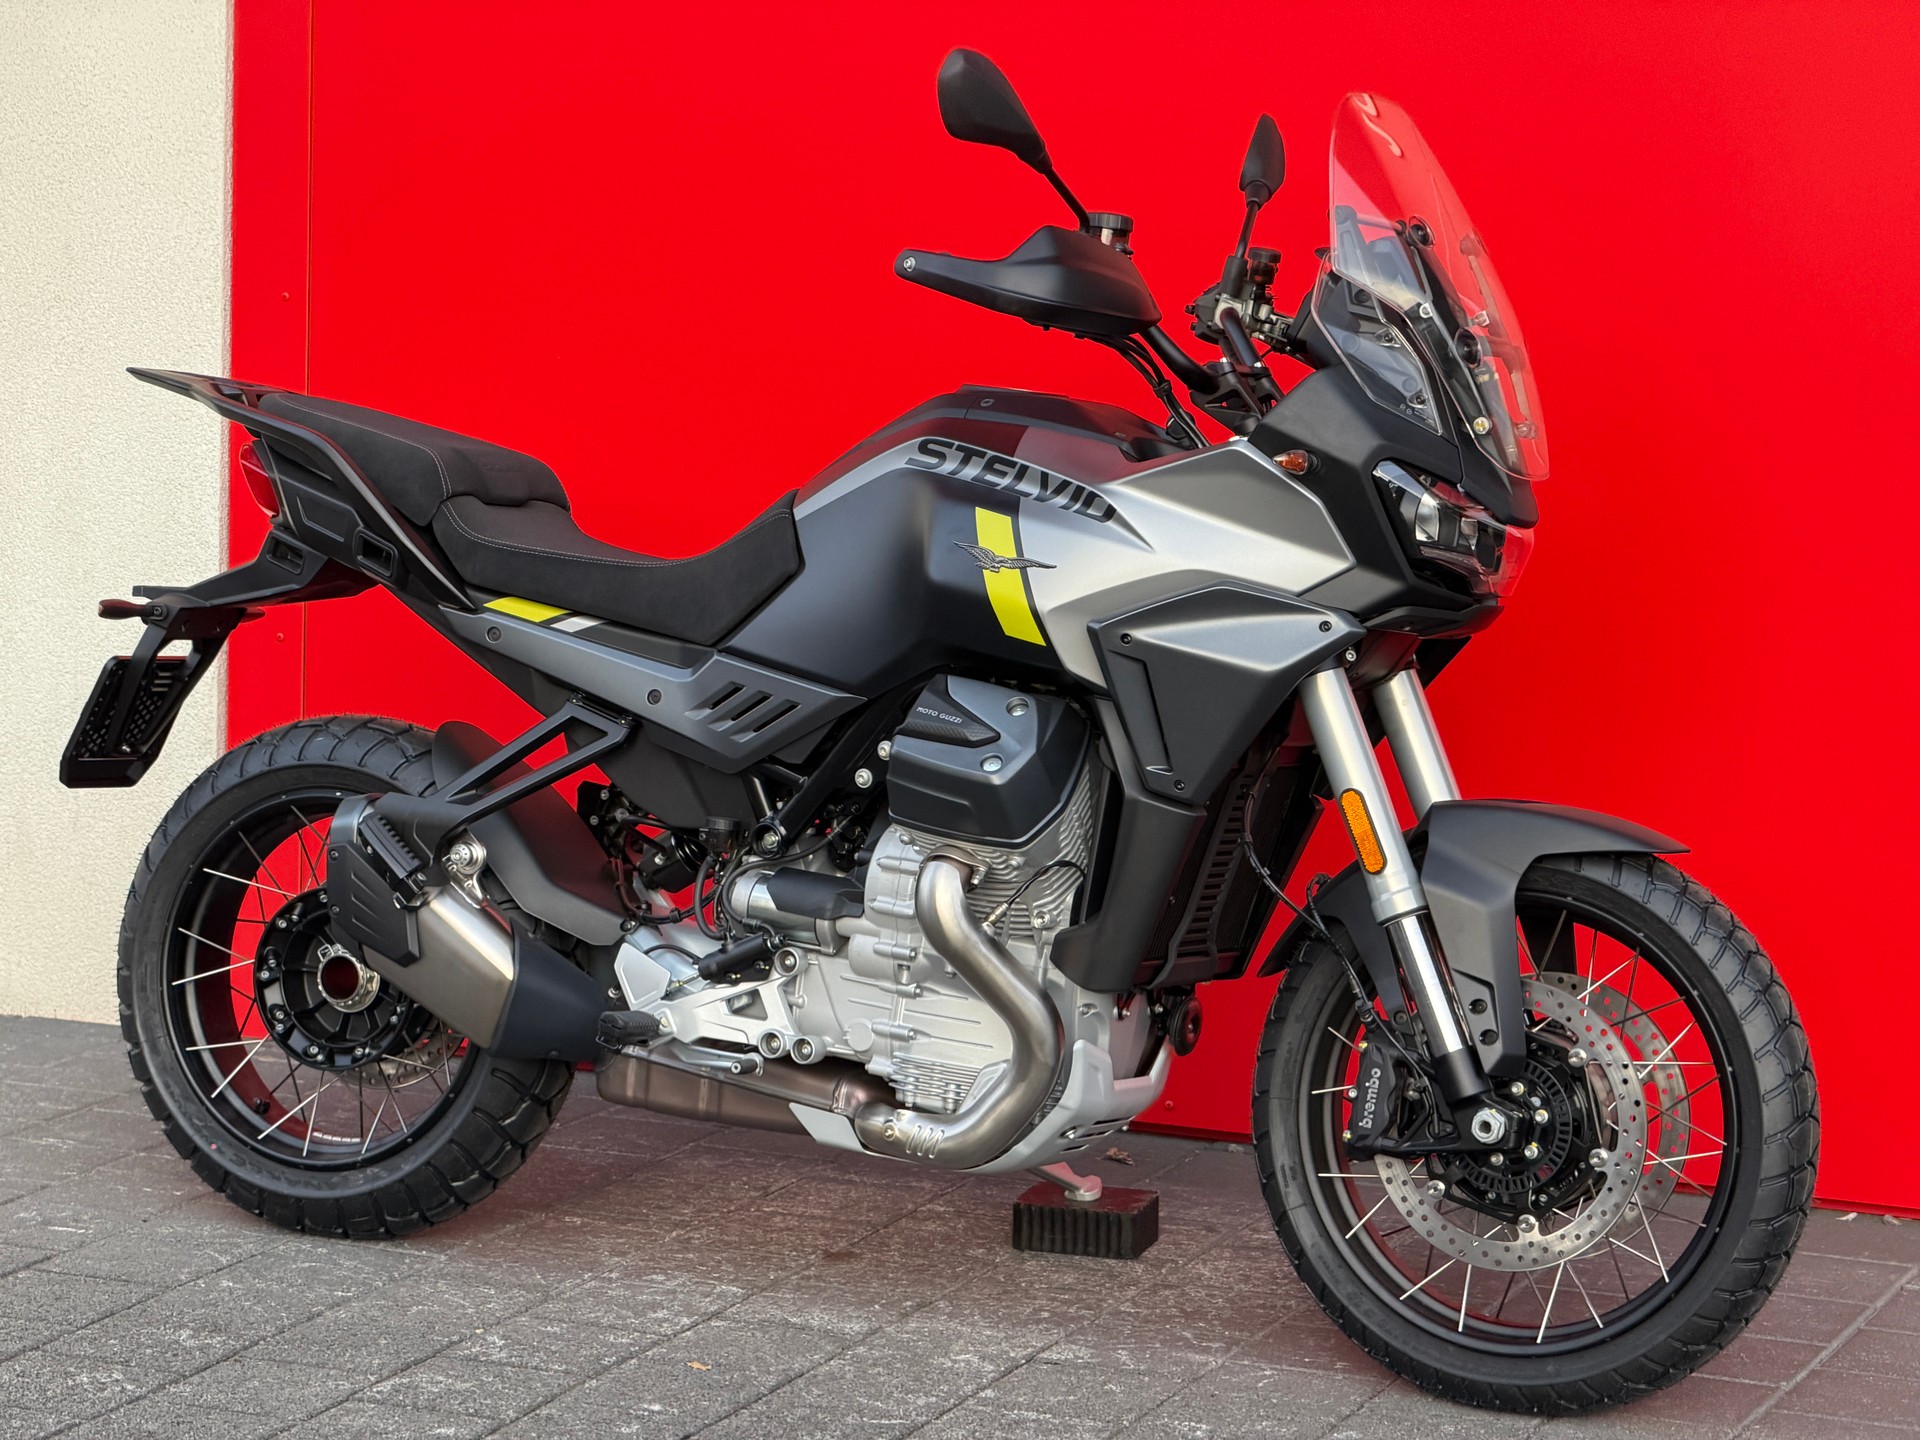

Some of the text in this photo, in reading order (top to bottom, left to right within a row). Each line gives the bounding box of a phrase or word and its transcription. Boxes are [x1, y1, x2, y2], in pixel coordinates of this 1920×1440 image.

[904, 438, 1117, 523] STELVIO
[916, 706, 963, 724] MOTO GUZZI
[1358, 1067, 1382, 1129] brembo
